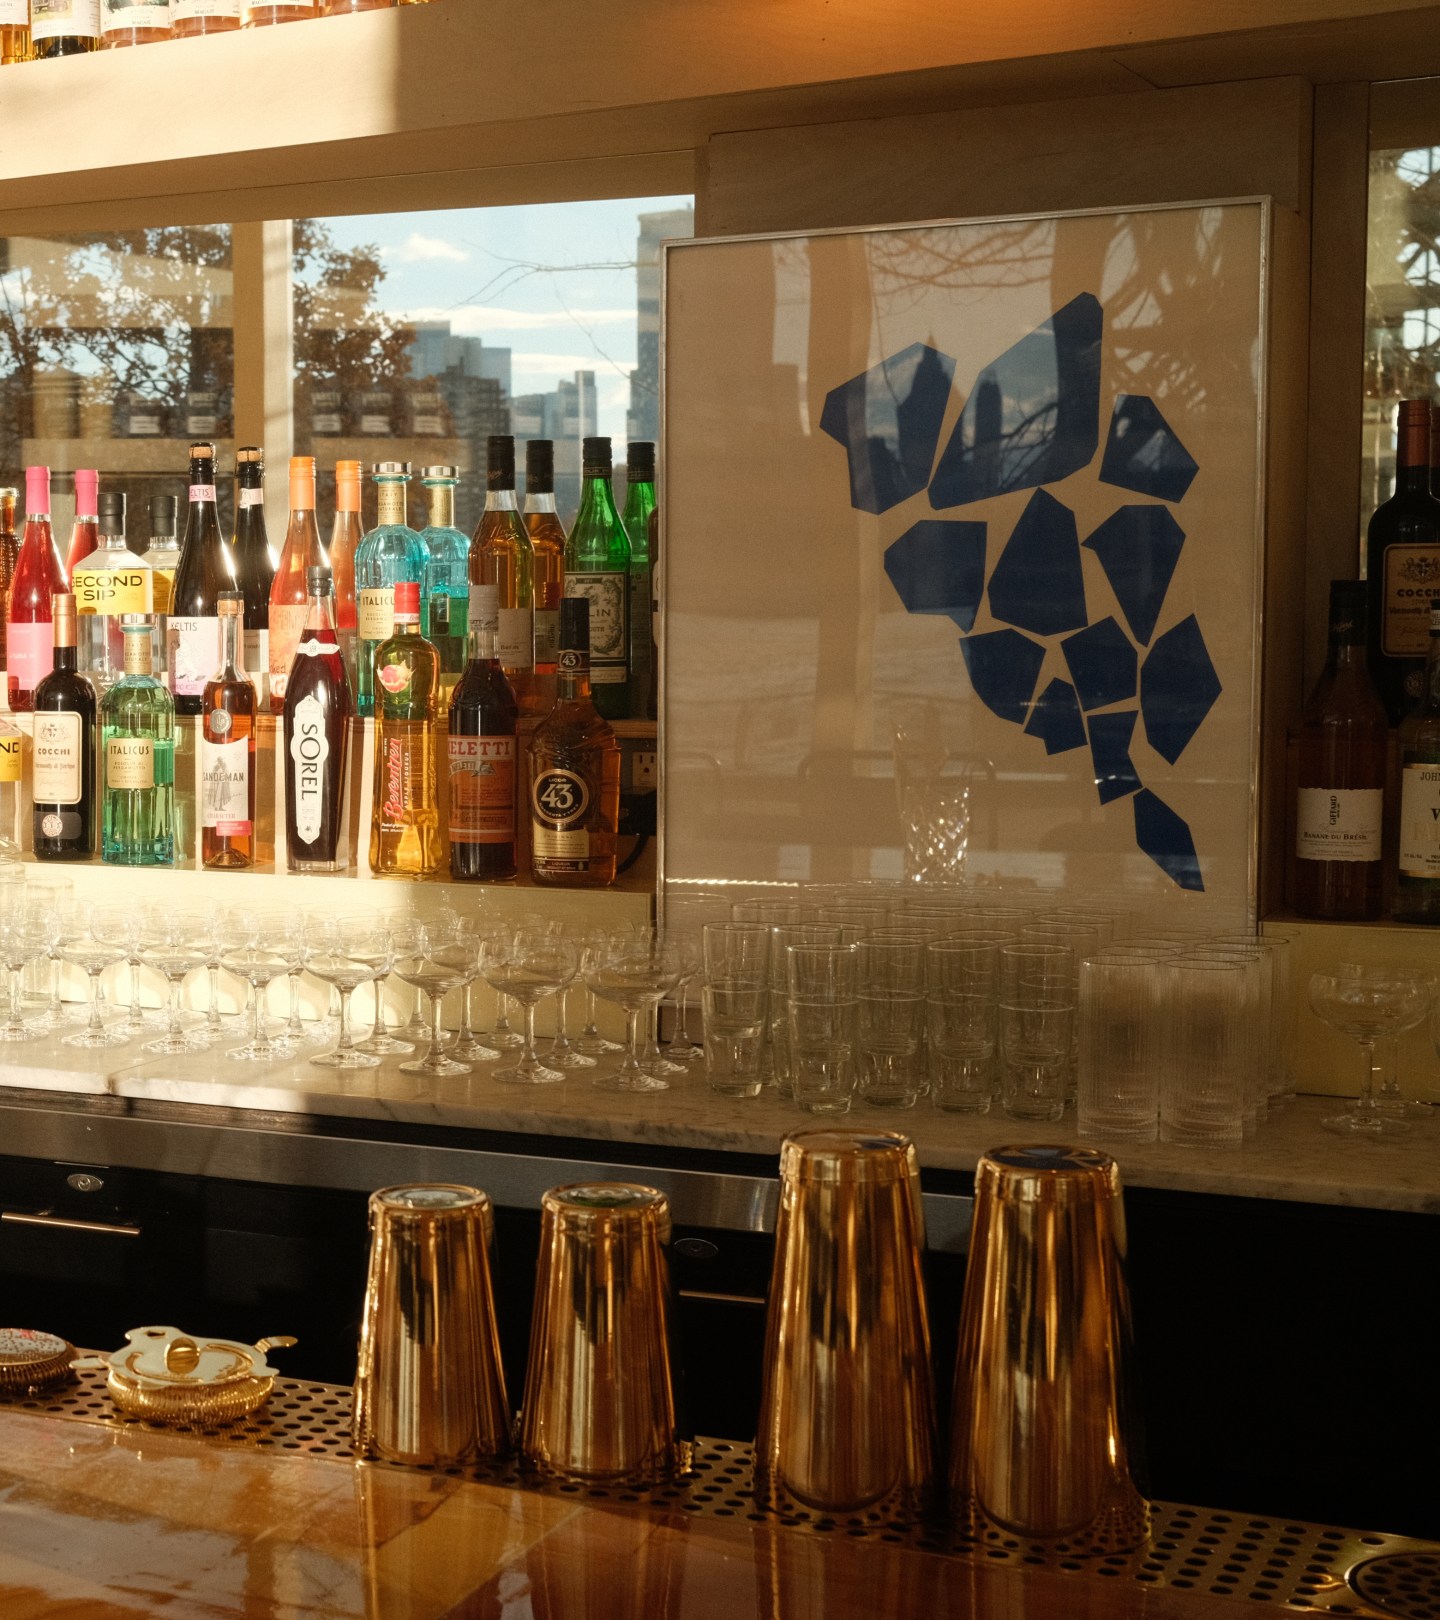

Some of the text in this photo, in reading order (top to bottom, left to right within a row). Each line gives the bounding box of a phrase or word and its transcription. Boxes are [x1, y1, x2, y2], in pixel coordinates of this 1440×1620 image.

[72, 575, 143, 587] SECOND
[83, 589, 116, 601] SIP
[1397, 588, 1440, 598] COCCH
[362, 596, 395, 606] ITALICU
[170, 622, 198, 631] KELTIS
[562, 655, 576, 666] 43
[38, 747, 71, 756] COCCHI
[111, 745, 149, 755] ITALICUS
[448, 740, 510, 755] ELETTI
[299, 723, 321, 801] SOREL
[203, 772, 244, 782] SANDEMAN
[541, 783, 574, 809] 43
